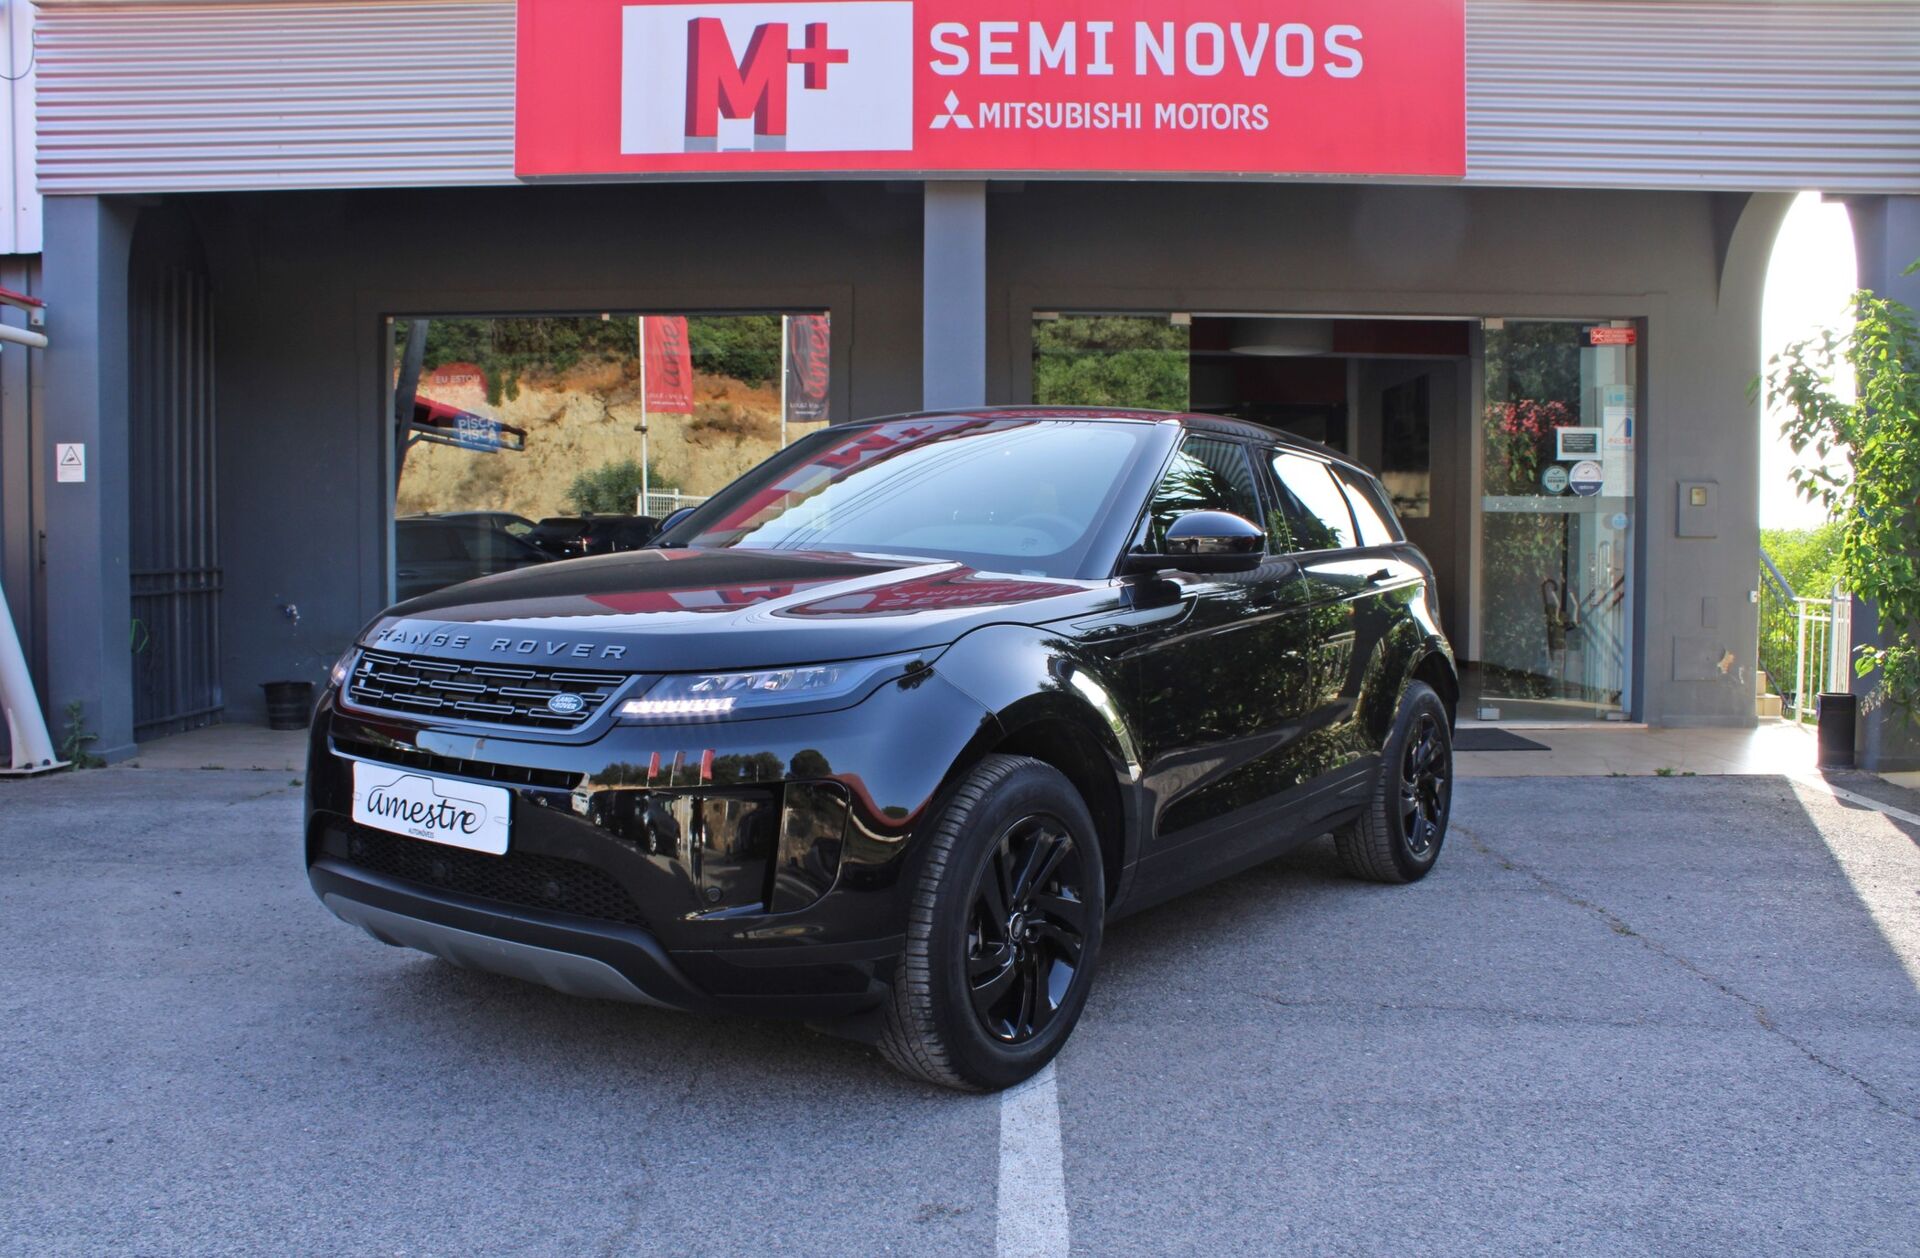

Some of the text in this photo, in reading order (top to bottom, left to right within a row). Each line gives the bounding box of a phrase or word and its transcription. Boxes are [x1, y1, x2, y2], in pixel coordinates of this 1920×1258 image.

[929, 20, 1364, 79] SEMI NOVOS
[979, 102, 1270, 130] MITSUBISHI MOTORS
[450, 375, 480, 383] ESTOU
[377, 628, 627, 660] RANGE ROVER
[367, 788, 477, 834] amestre
